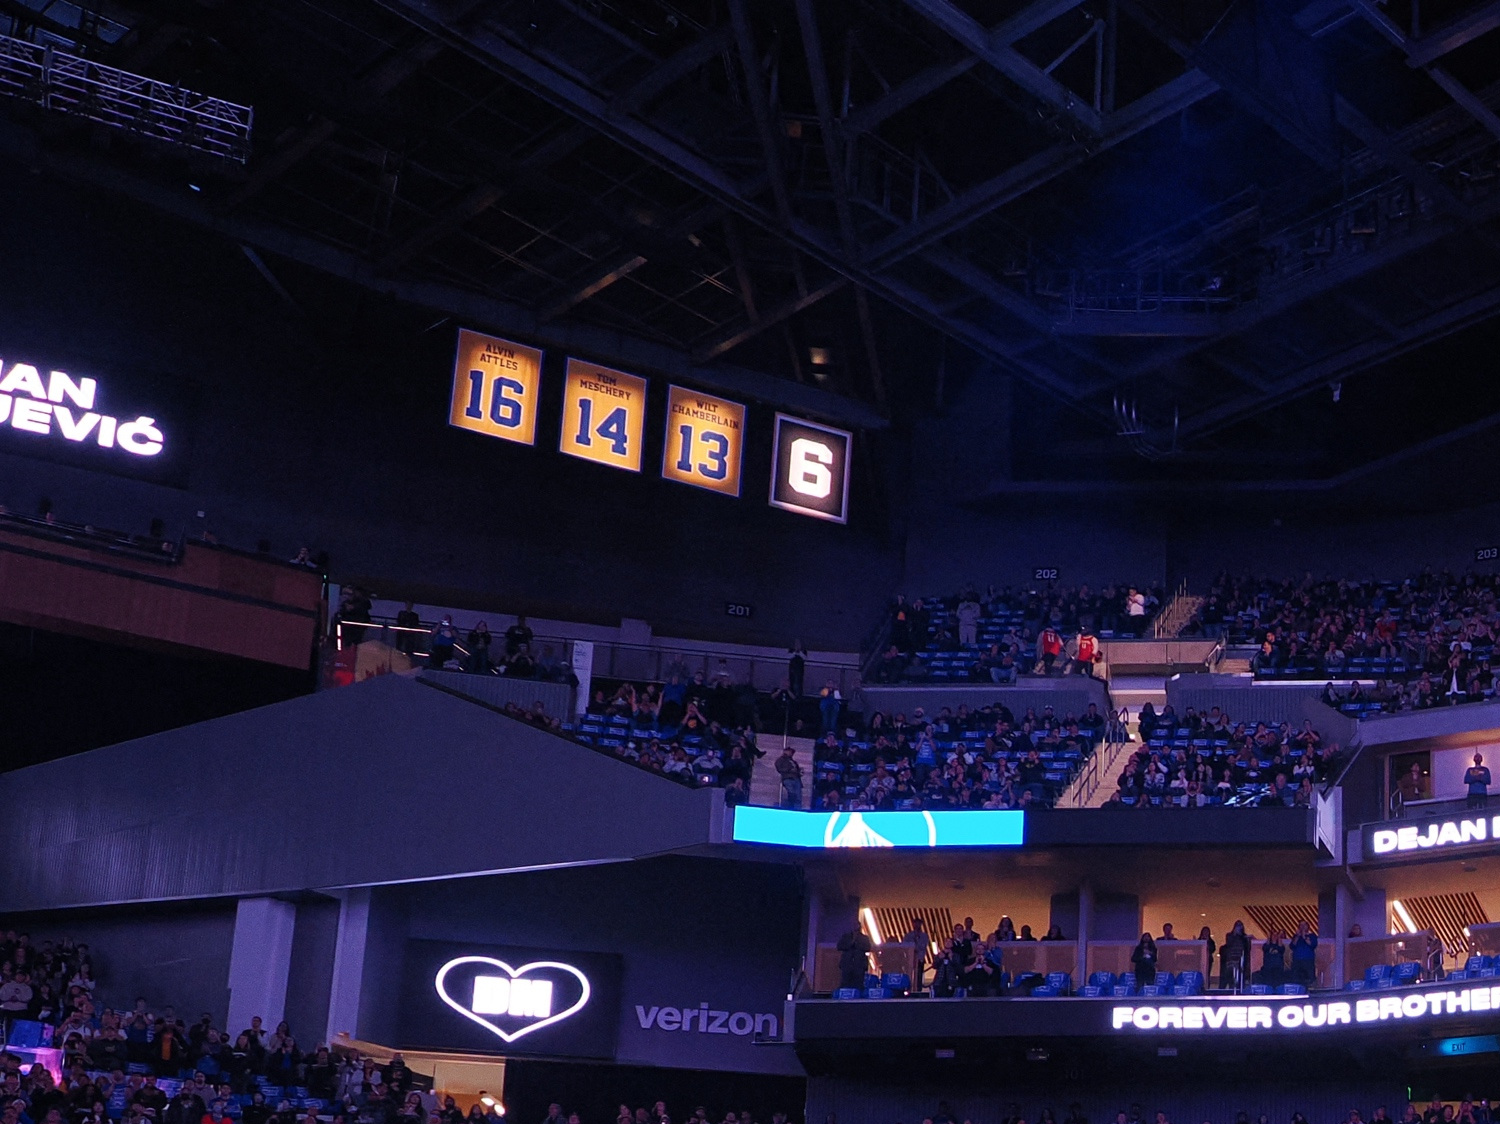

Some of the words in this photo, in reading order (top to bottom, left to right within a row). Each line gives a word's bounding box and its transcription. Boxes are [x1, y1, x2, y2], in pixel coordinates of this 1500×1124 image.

[480, 352, 519, 371] ATTLES
[485, 343, 515, 360] ALVIN
[0, 359, 97, 410] AN
[579, 379, 632, 400] MESCHERY
[596, 372, 618, 387] TOM
[465, 369, 524, 429] 16
[696, 399, 719, 413] WILT
[574, 397, 629, 456] 14
[672, 403, 739, 430] CHAMBERLAIN
[677, 424, 730, 481] 13
[788, 438, 833, 499] 6
[1477, 548, 1498, 560] 203
[1035, 569, 1058, 579] 202
[727, 604, 750, 617] 201
[1373, 818, 1487, 854] DEJAN
[471, 974, 554, 1019] DM
[634, 1002, 778, 1037] verizon
[1112, 1006, 1273, 1030] FOREVER
[1277, 1001, 1352, 1028] OUR
[1451, 1043, 1467, 1052] EXIT
